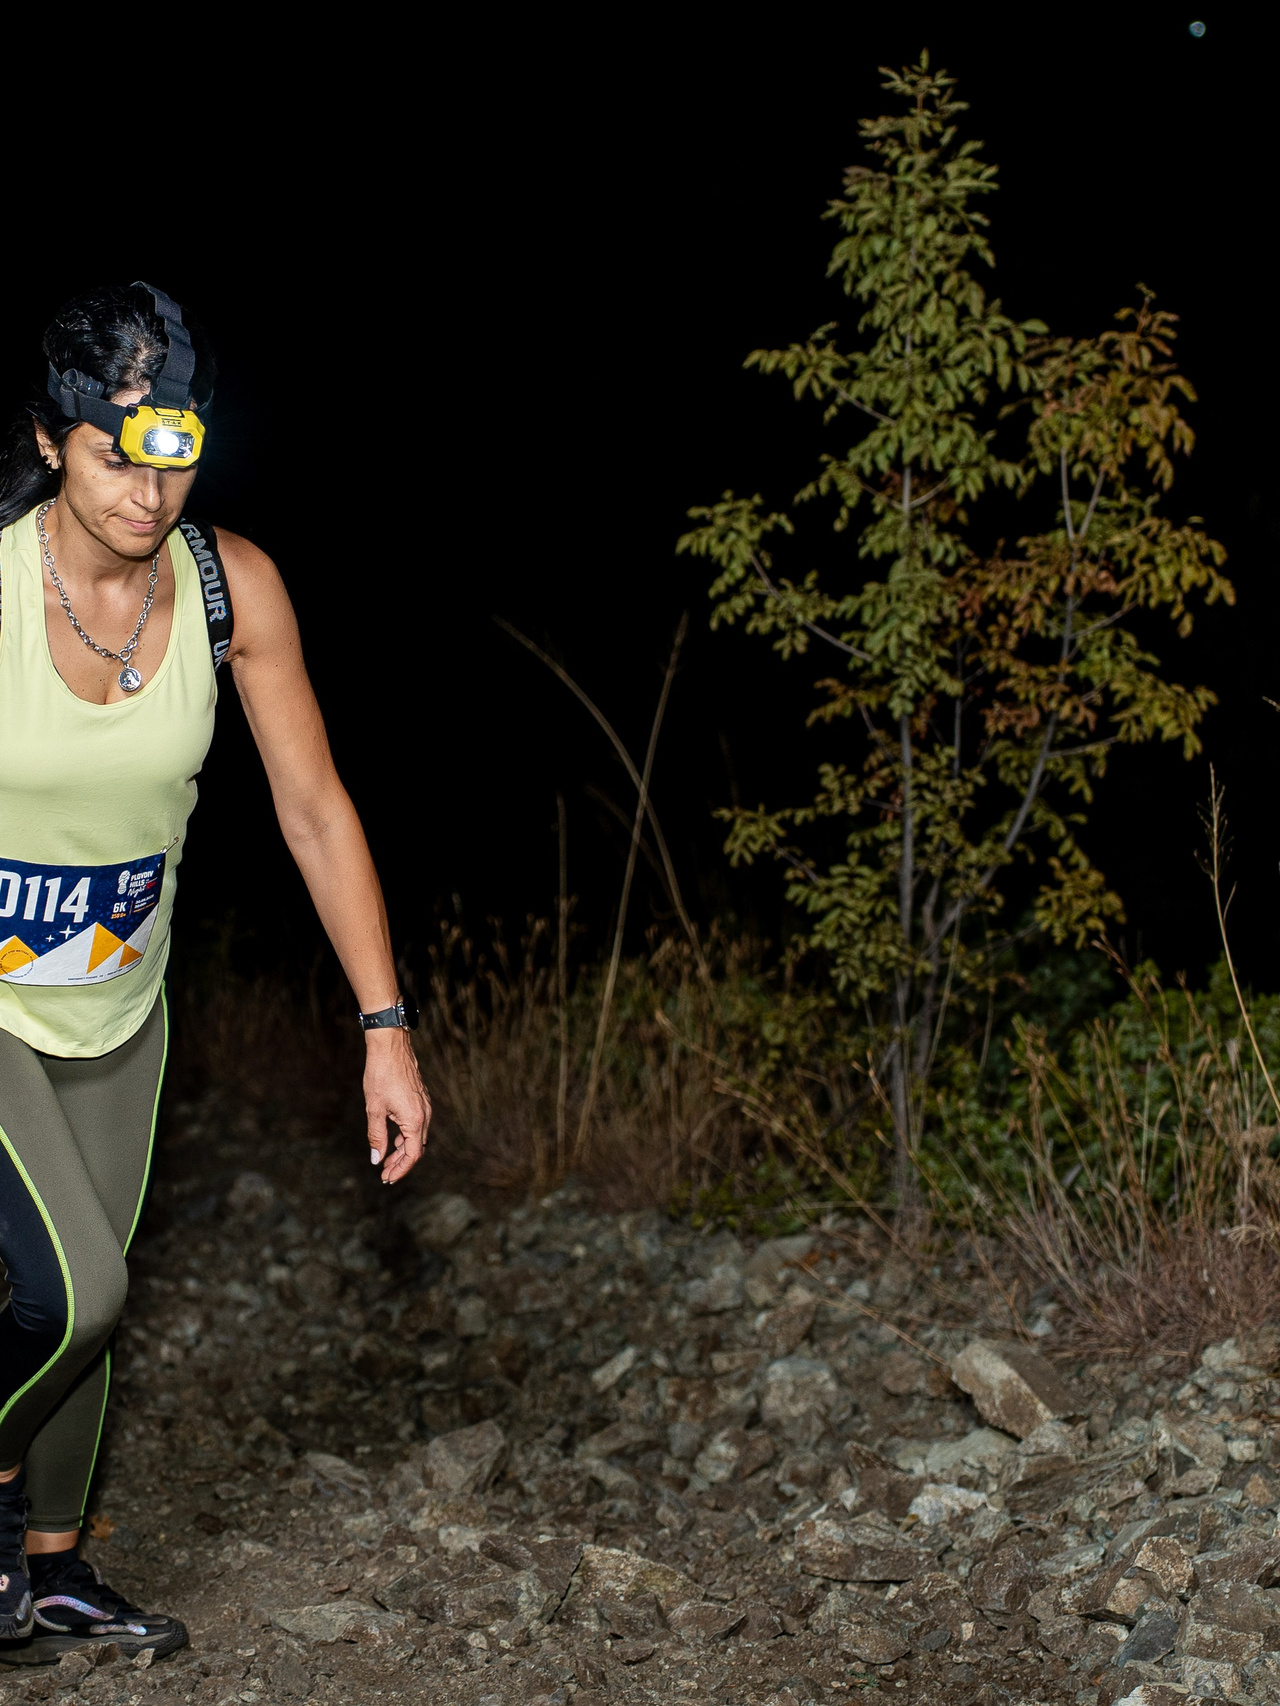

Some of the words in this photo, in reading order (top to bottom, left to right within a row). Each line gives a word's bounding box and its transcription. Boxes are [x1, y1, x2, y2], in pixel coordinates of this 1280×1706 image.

[179, 517, 227, 622] RMOUR
[131, 870, 154, 881] PLOVDIV
[113, 901, 127, 913] 6K
